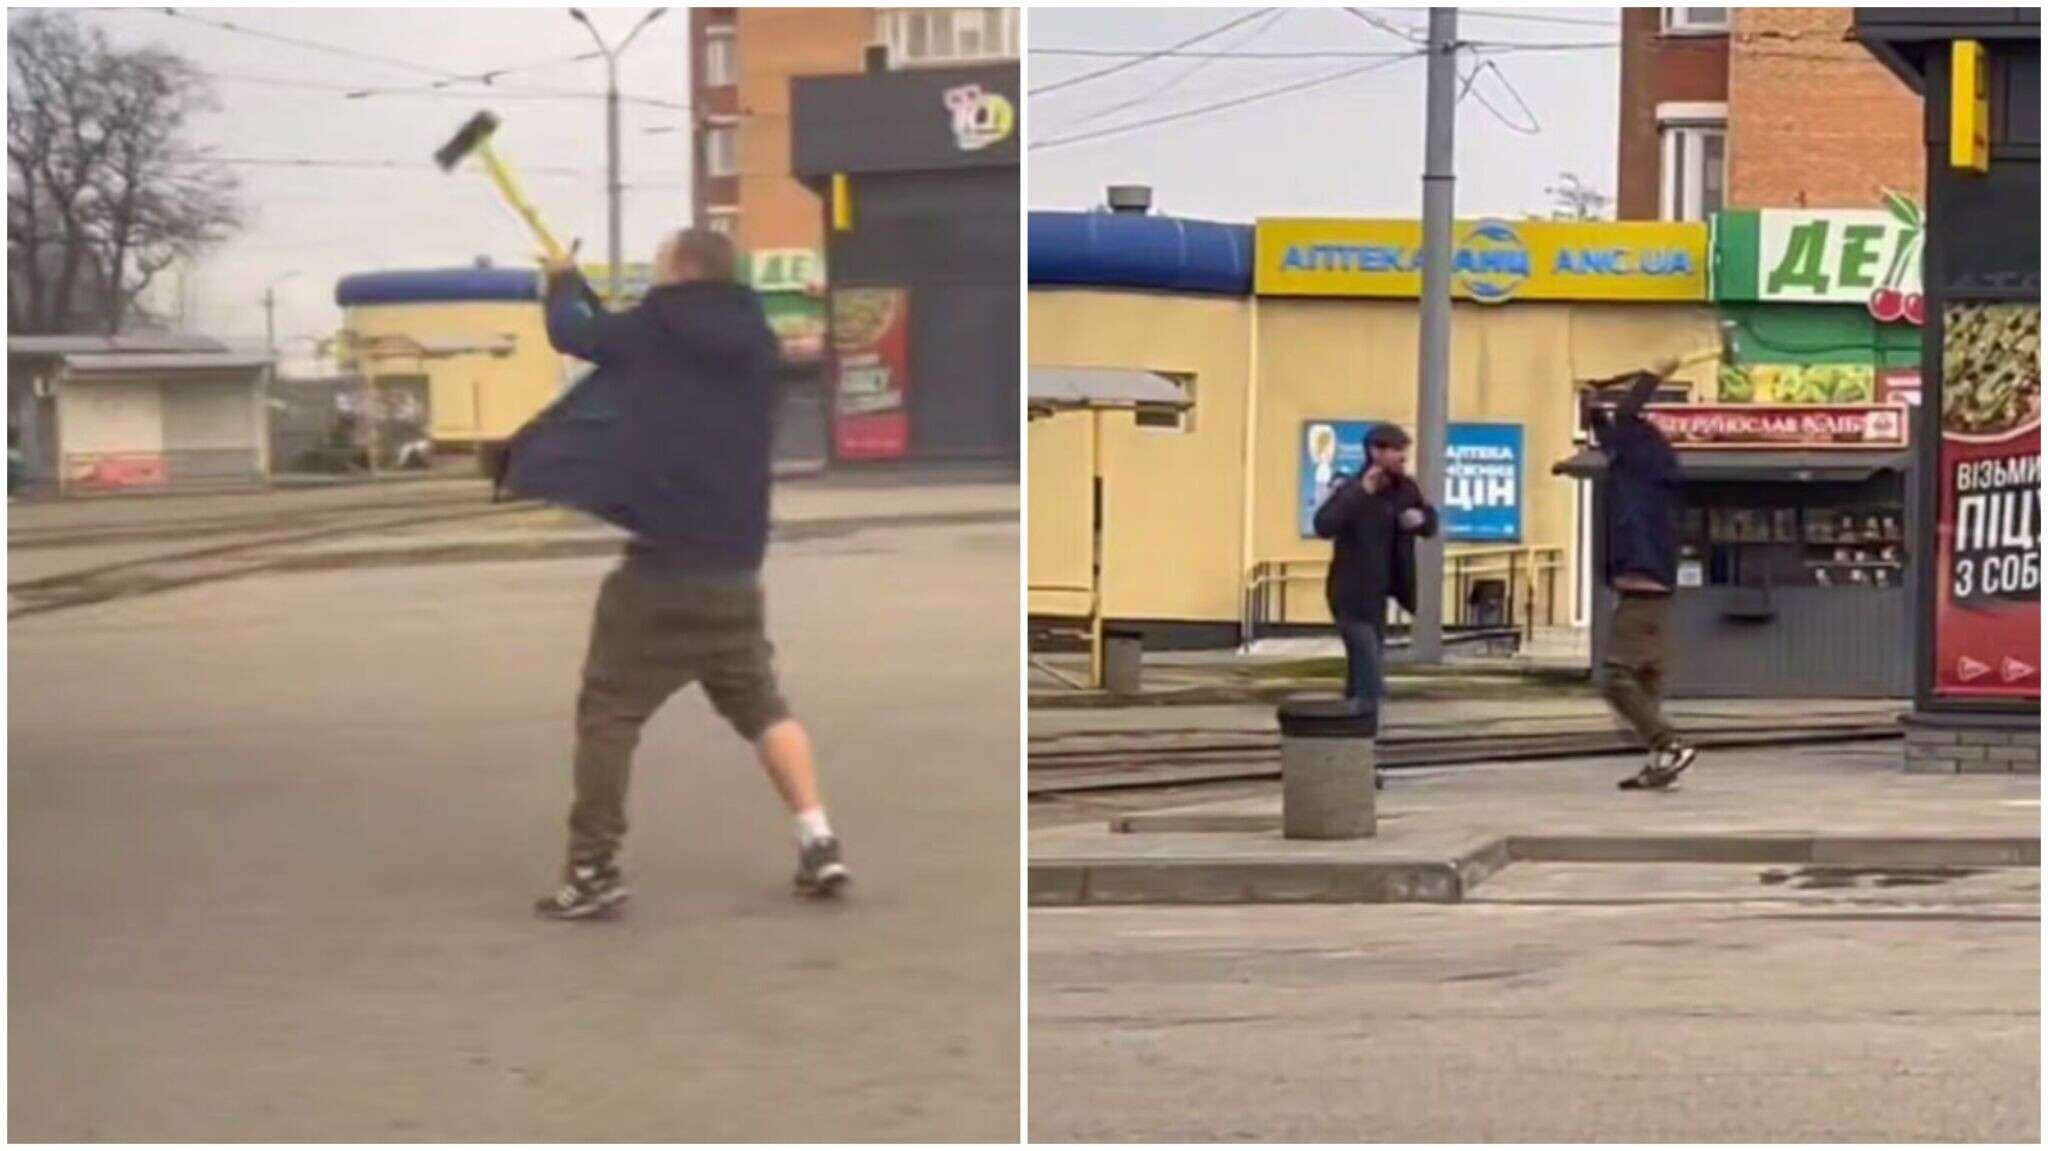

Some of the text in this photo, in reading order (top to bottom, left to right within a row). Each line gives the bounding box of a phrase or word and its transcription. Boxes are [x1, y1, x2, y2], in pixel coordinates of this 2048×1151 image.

[1445, 477, 1514, 511] ЦІН
[1956, 488, 2041, 551] ПІЦ
[1982, 552, 2040, 594] СОБ
